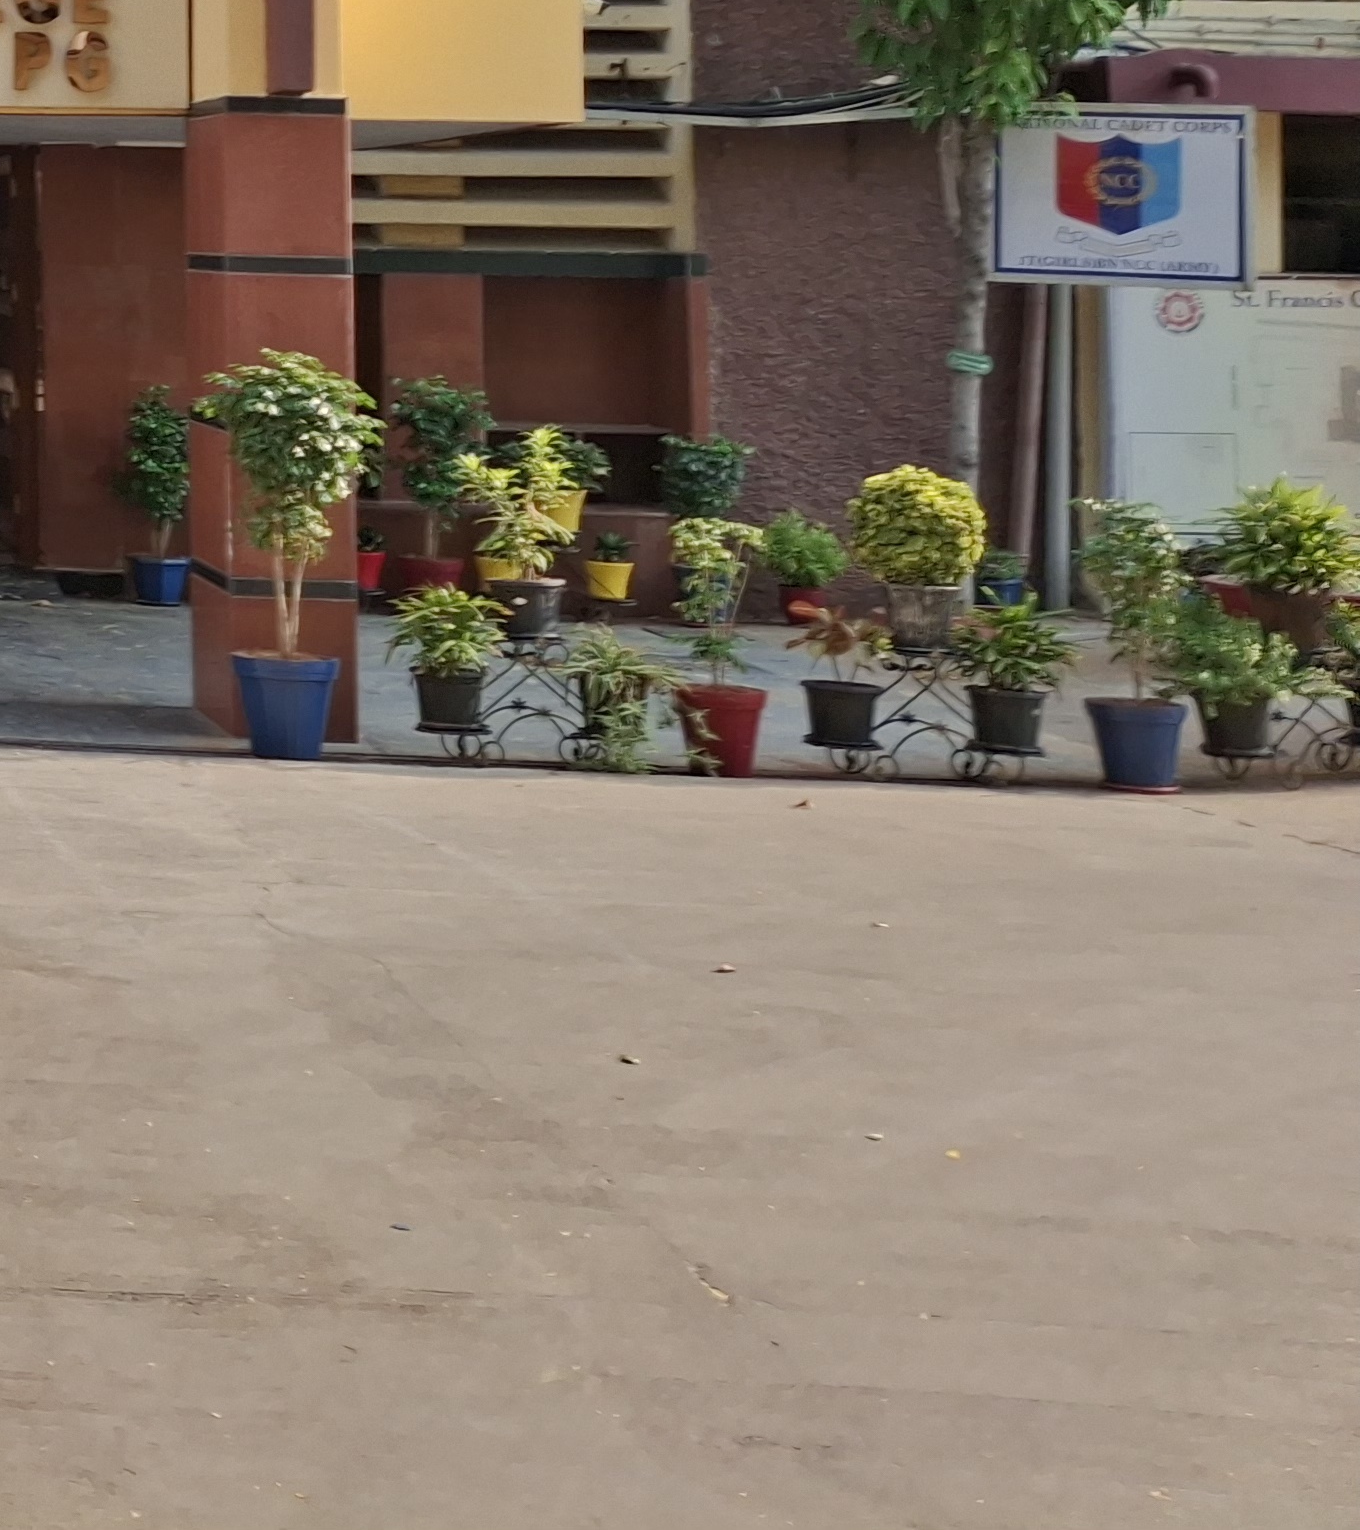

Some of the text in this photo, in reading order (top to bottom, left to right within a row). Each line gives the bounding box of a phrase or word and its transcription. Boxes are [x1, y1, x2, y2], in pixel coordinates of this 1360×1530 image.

[13, 29, 111, 92] PG
[1107, 119, 1164, 132] CADET
[1173, 121, 1233, 134] CORPS
[1267, 290, 1346, 308] Francis
